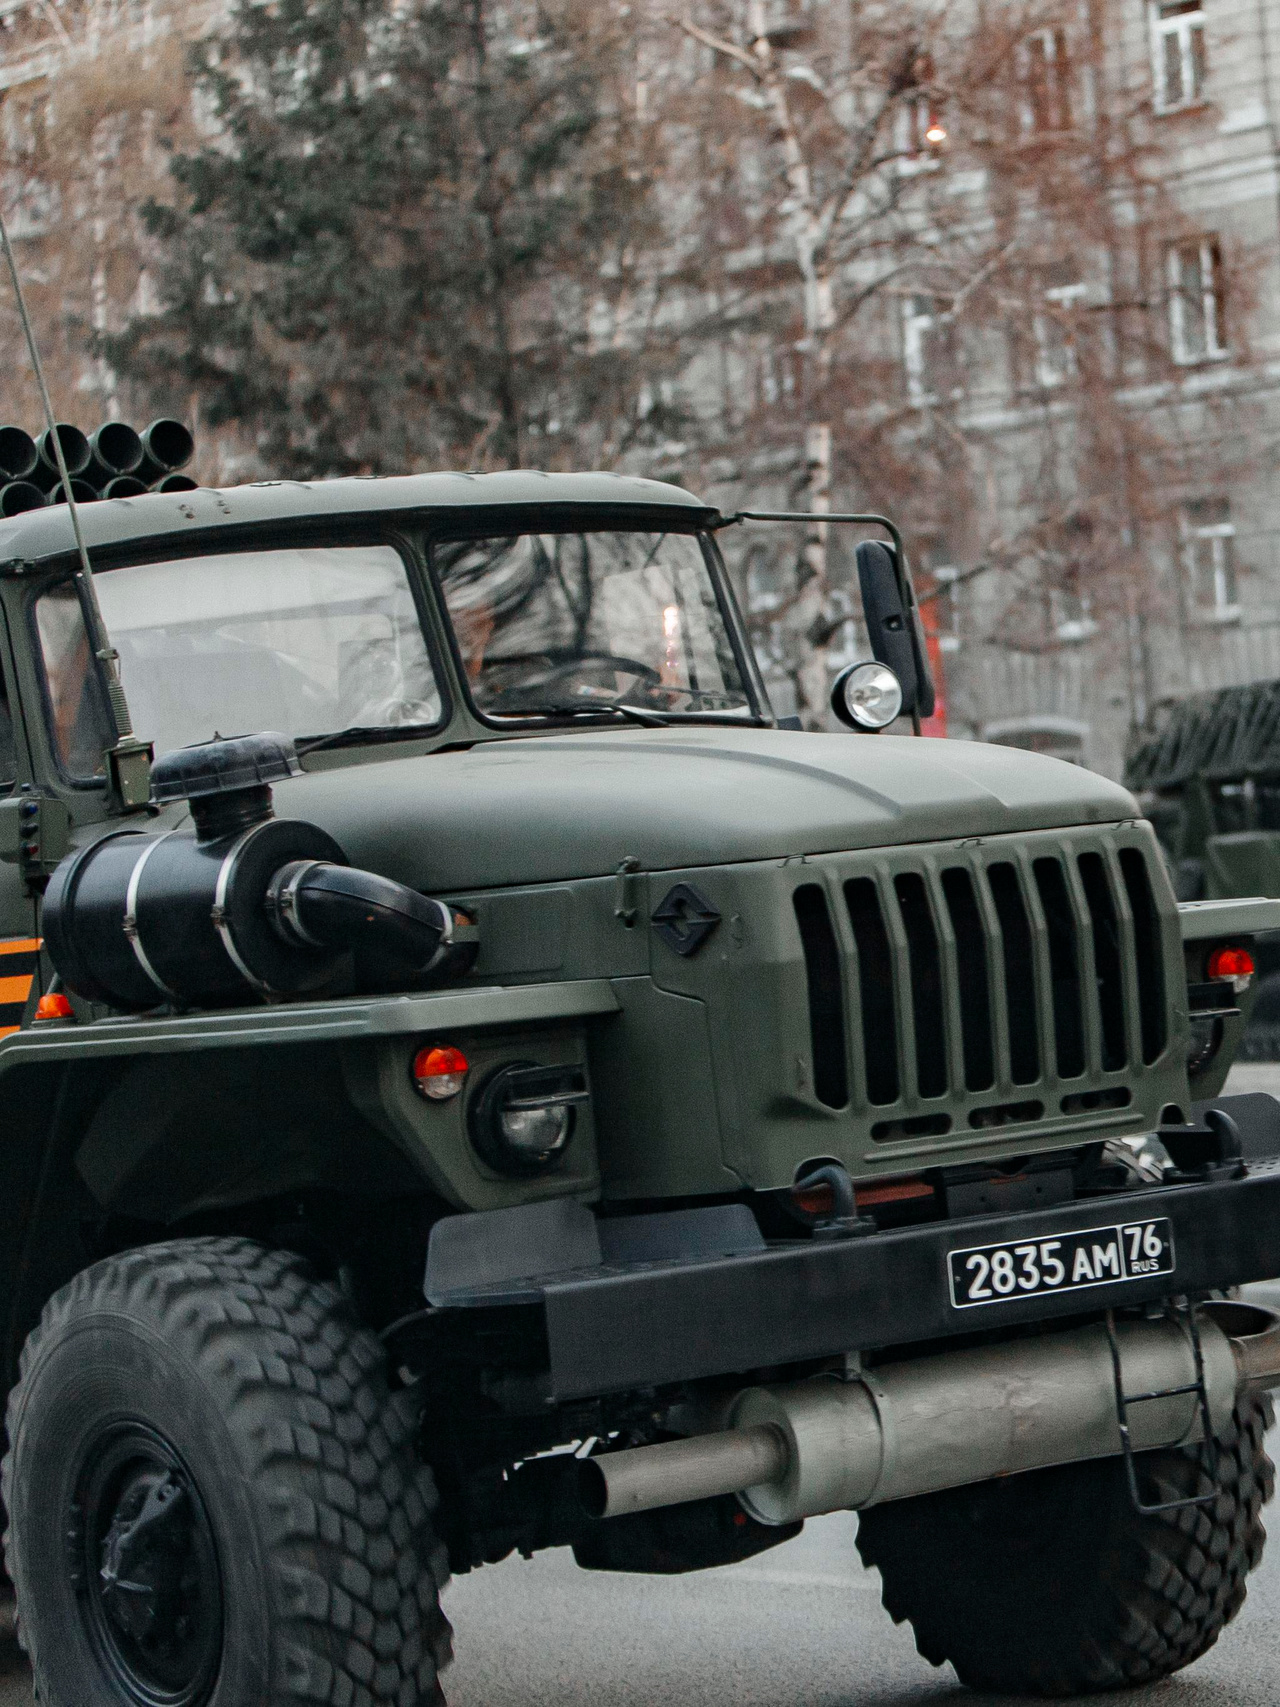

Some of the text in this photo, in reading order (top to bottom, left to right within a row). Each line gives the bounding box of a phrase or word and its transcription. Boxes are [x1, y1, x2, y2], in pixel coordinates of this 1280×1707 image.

[966, 1224, 1163, 1299] 2835 AM 76
[1132, 1259, 1160, 1273] RUS
